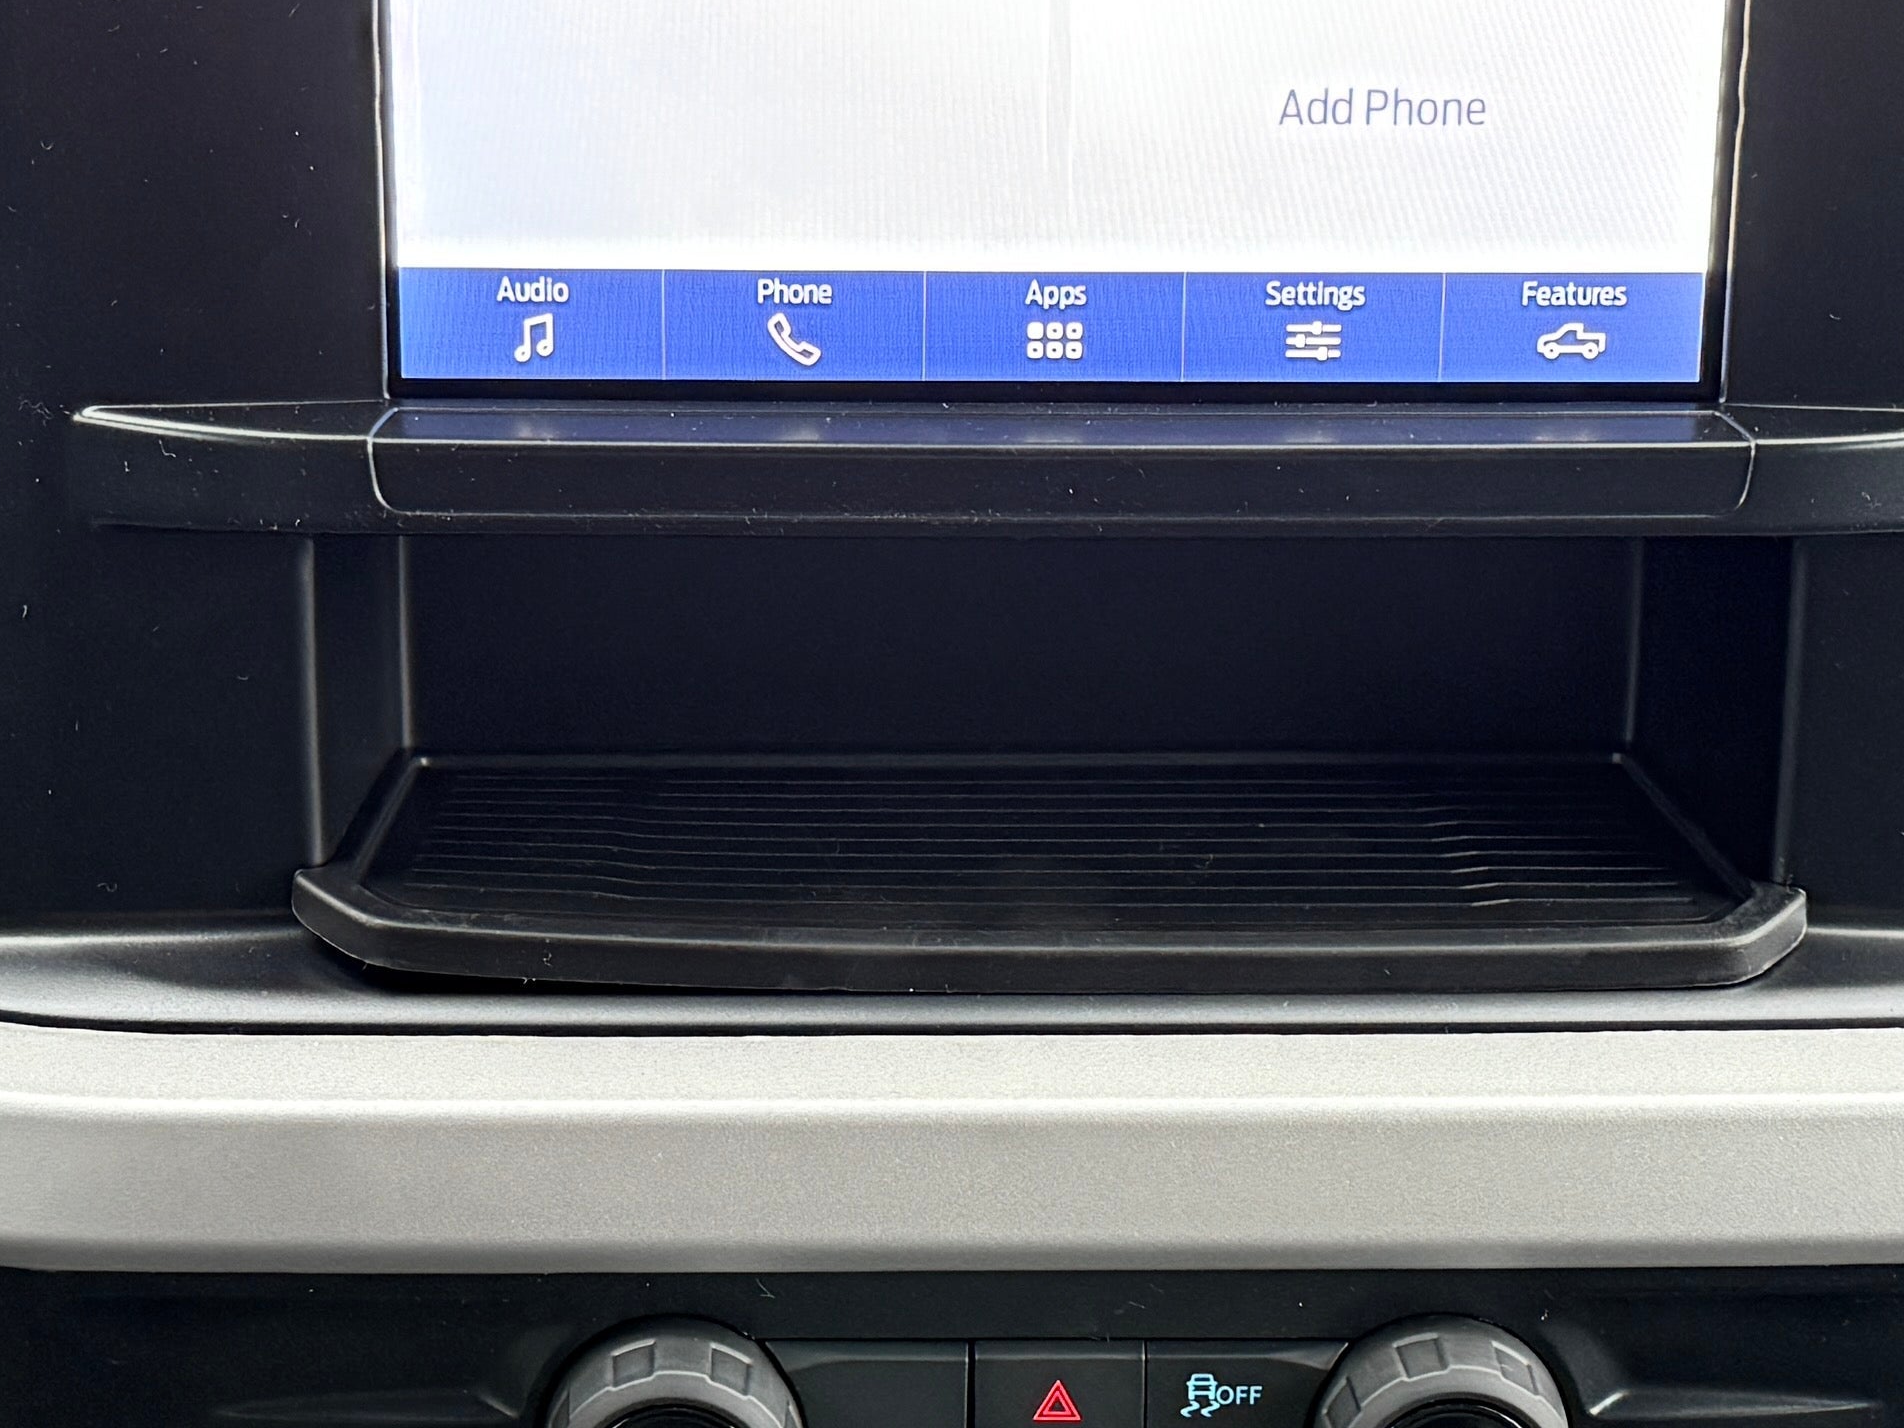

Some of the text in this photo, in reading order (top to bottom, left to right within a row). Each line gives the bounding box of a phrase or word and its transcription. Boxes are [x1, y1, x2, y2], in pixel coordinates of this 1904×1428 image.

[1278, 86, 1487, 127] Add Phone
[496, 276, 1627, 311] Audio Phone Apps Settings Features
[1216, 1382, 1264, 1409] OFF
